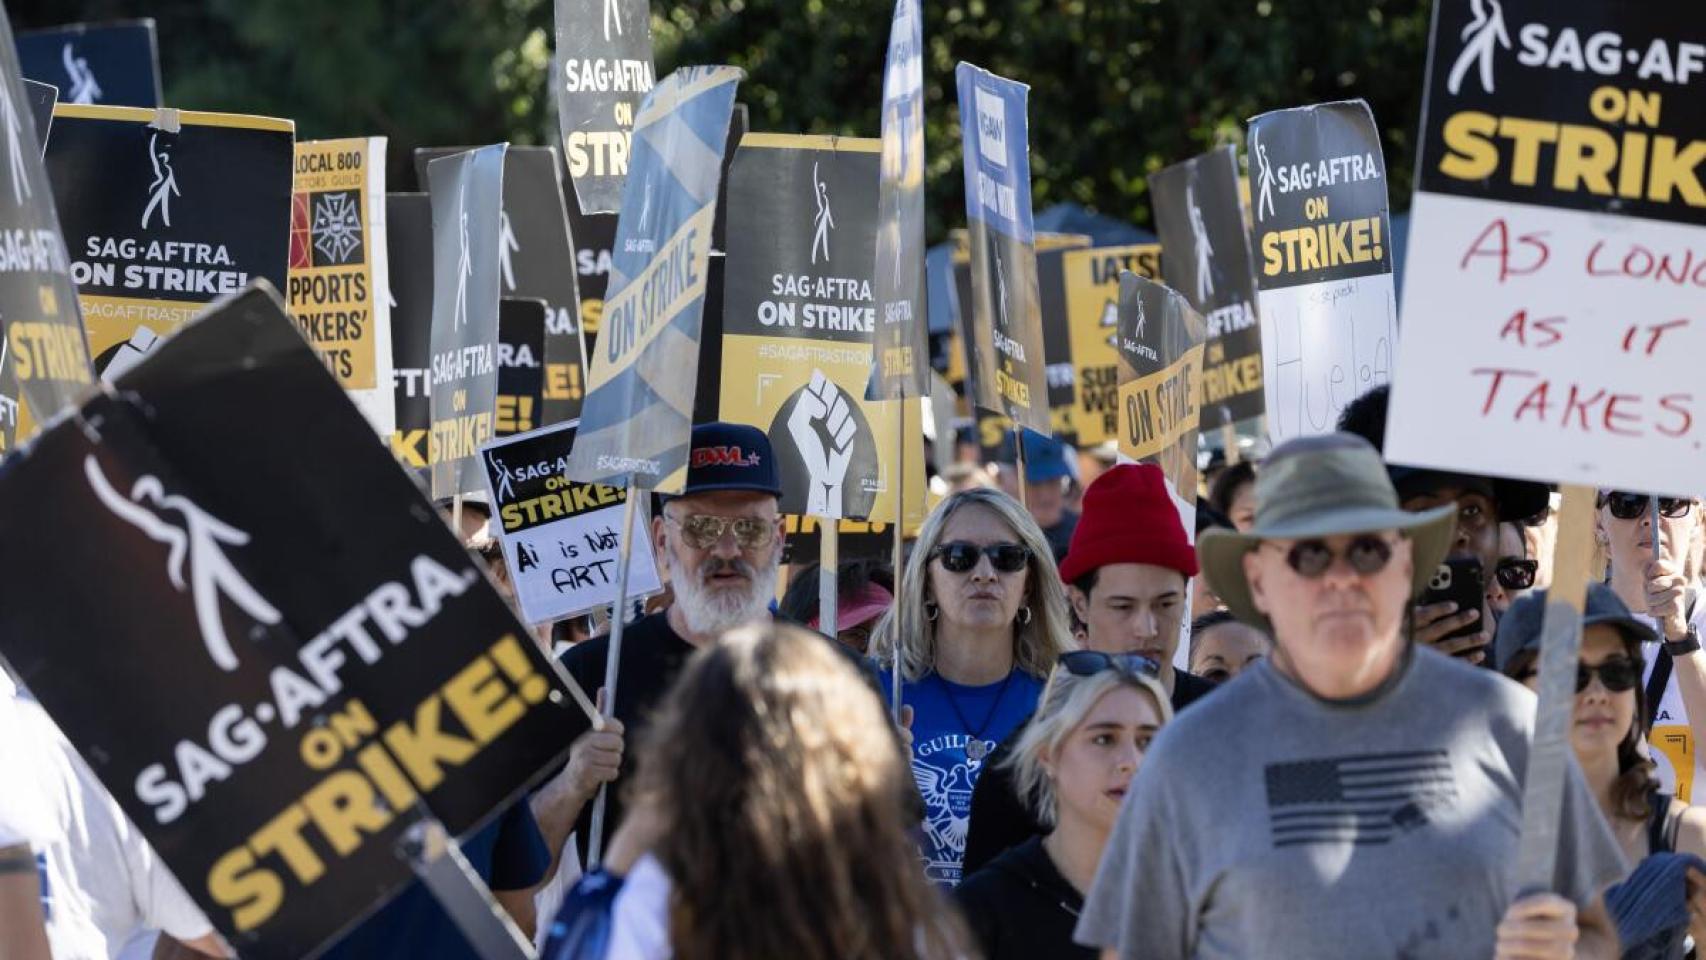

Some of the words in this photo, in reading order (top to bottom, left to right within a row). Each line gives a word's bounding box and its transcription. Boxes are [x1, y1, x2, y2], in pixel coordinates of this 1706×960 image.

[1589, 86, 1661, 127] ON
[295, 153, 333, 174] LOCAL
[337, 150, 361, 171] 800
[1439, 111, 1706, 208] STRIK
[1304, 196, 1328, 220] ON
[1261, 216, 1383, 277] STRIKE!
[1461, 219, 1550, 283] AS
[69, 261, 115, 287] ON
[124, 264, 249, 295] STRIKE!
[289, 271, 366, 306] PPORTS
[608, 292, 636, 364] ON
[641, 227, 698, 336] STRIKE
[757, 299, 796, 327] ON
[801, 303, 875, 333] STRIKE
[1500, 309, 1567, 349] AS
[1621, 318, 1690, 356] IT
[1126, 389, 1154, 447] ON
[515, 458, 569, 483] SAG·A
[545, 474, 571, 491] ON
[551, 558, 615, 594] ART
[300, 700, 378, 770] ON
[207, 633, 550, 932] STRIKE!
